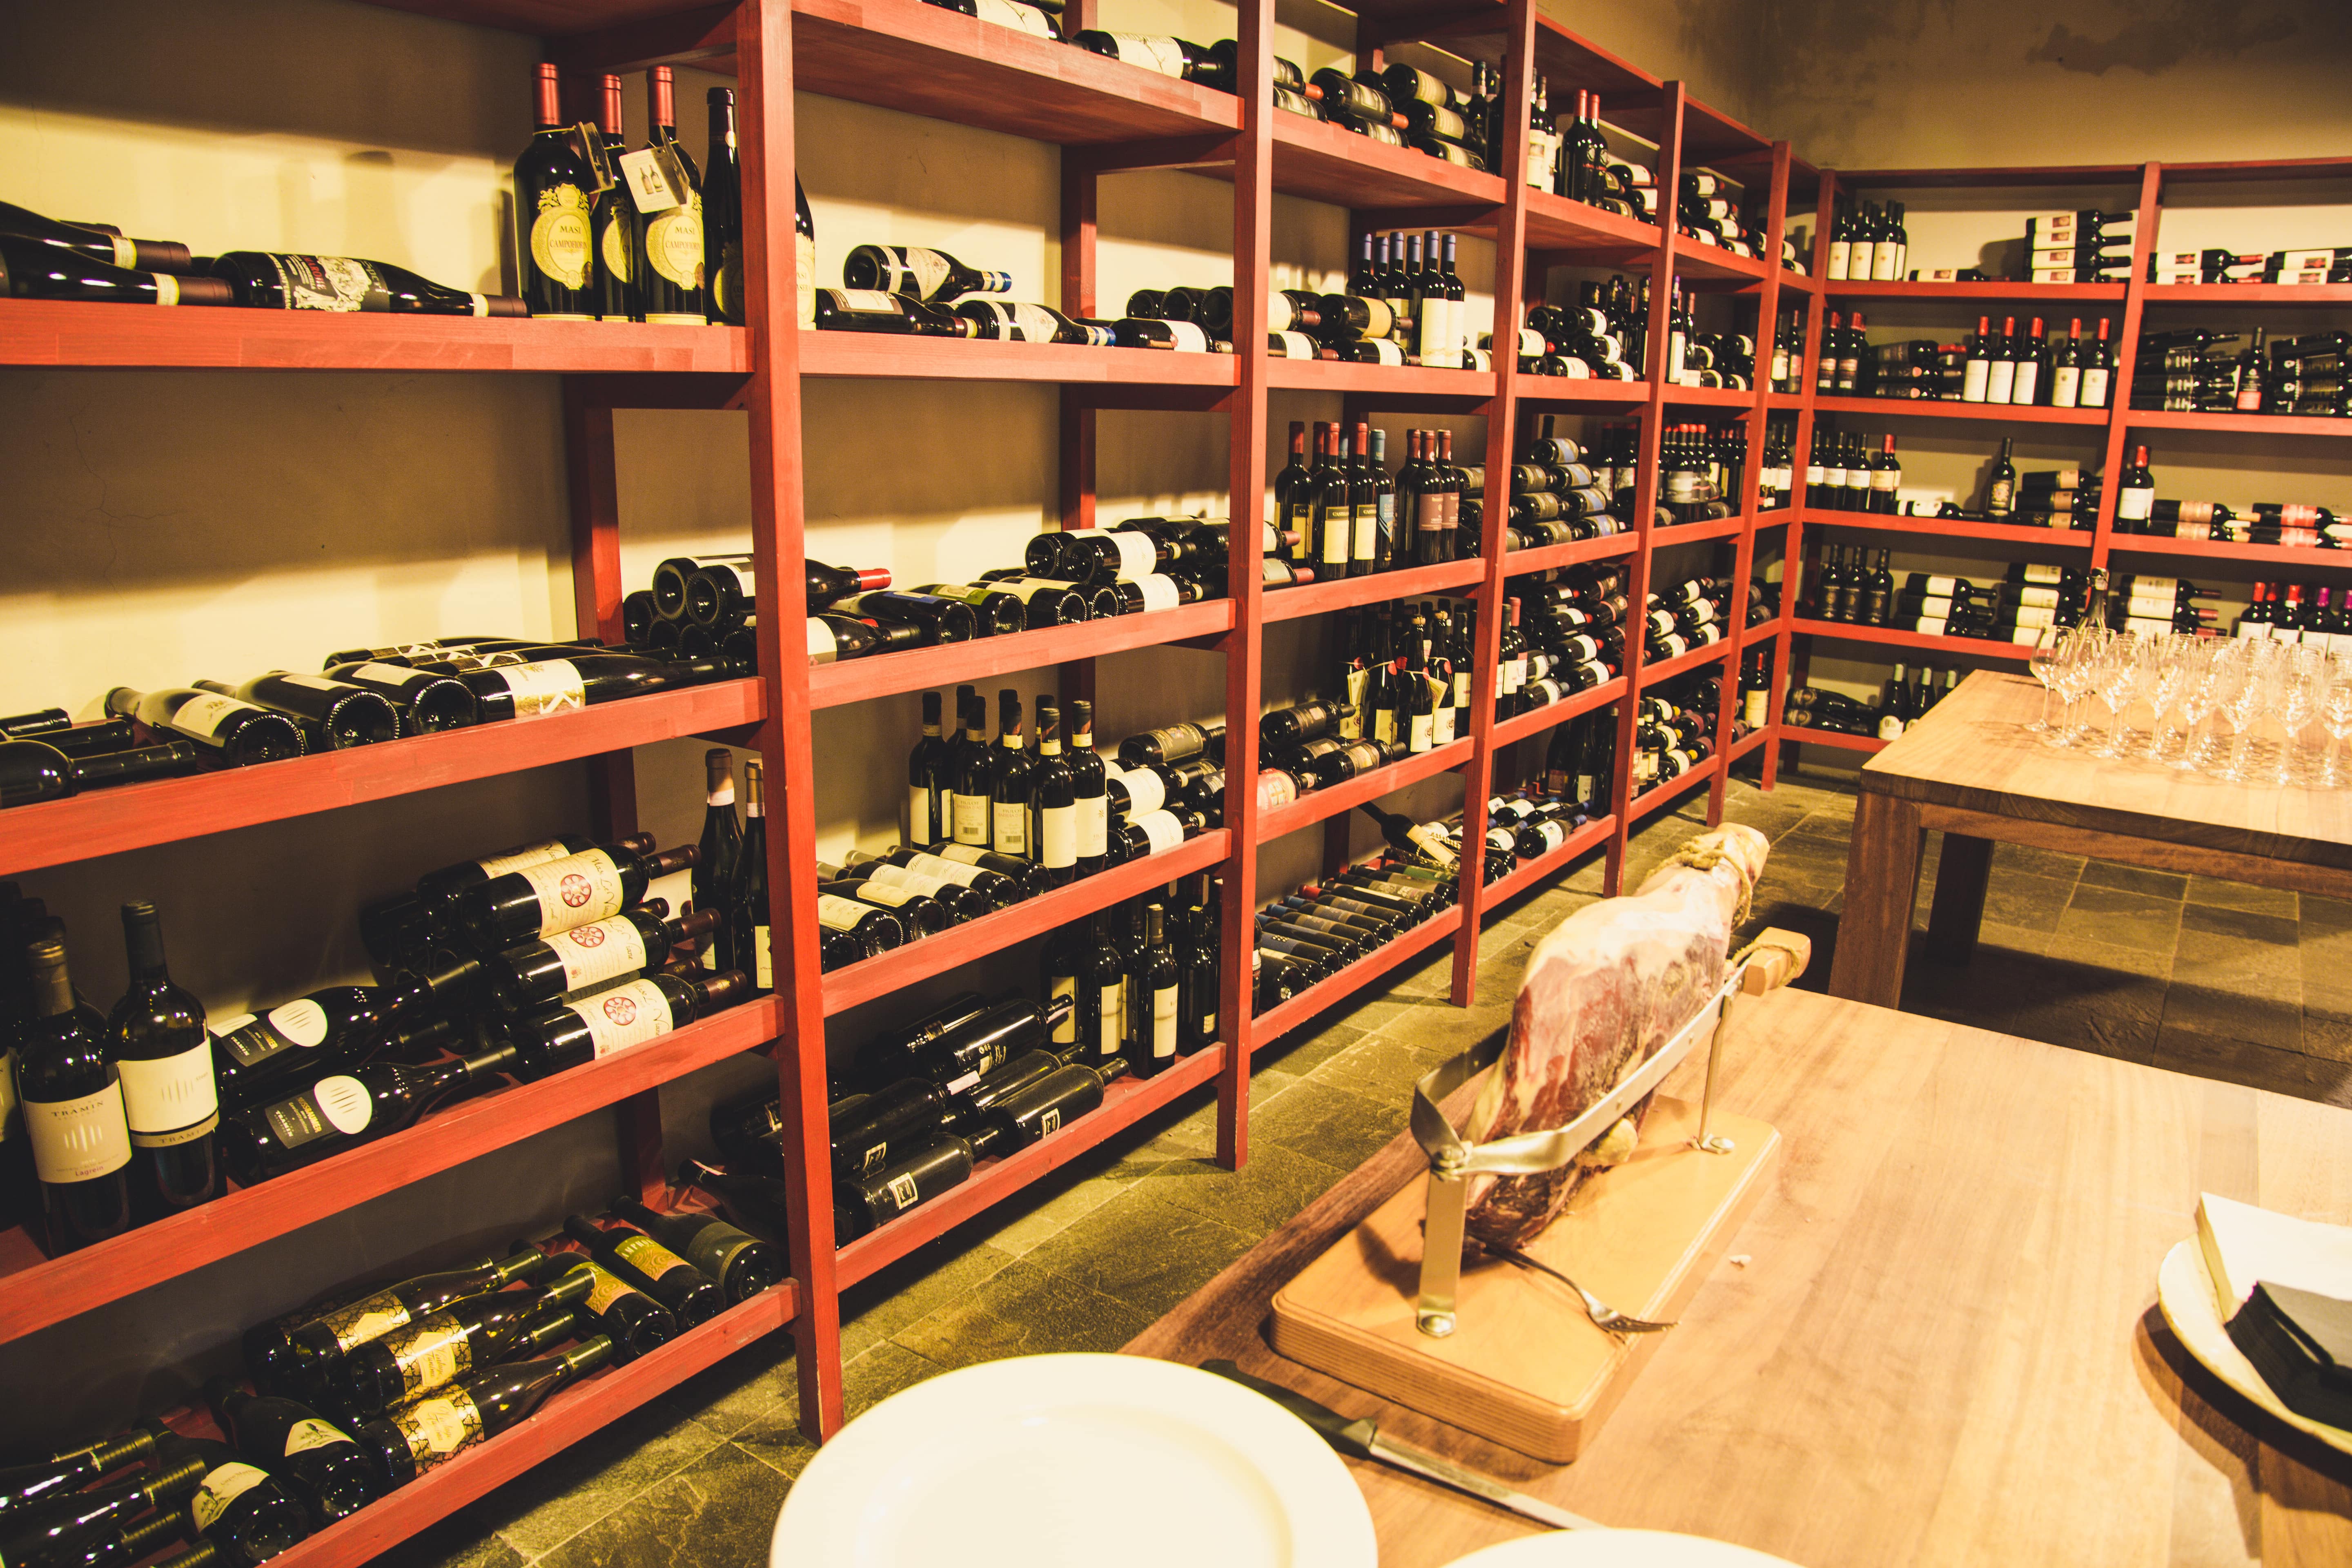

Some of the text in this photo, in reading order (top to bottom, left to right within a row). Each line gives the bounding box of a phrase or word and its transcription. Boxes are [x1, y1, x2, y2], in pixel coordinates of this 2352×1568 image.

[560, 225, 581, 234] MASI
[675, 226, 695, 234] MASI
[230, 1036, 250, 1056] TRAMIN
[51, 1100, 103, 1117] TRAMIN
[298, 1096, 322, 1133] NUSSBAUMER
[275, 1110, 294, 1137] TRAMIN
[160, 1126, 207, 1143] TRAMIN
[75, 1165, 105, 1177] Lagrein
